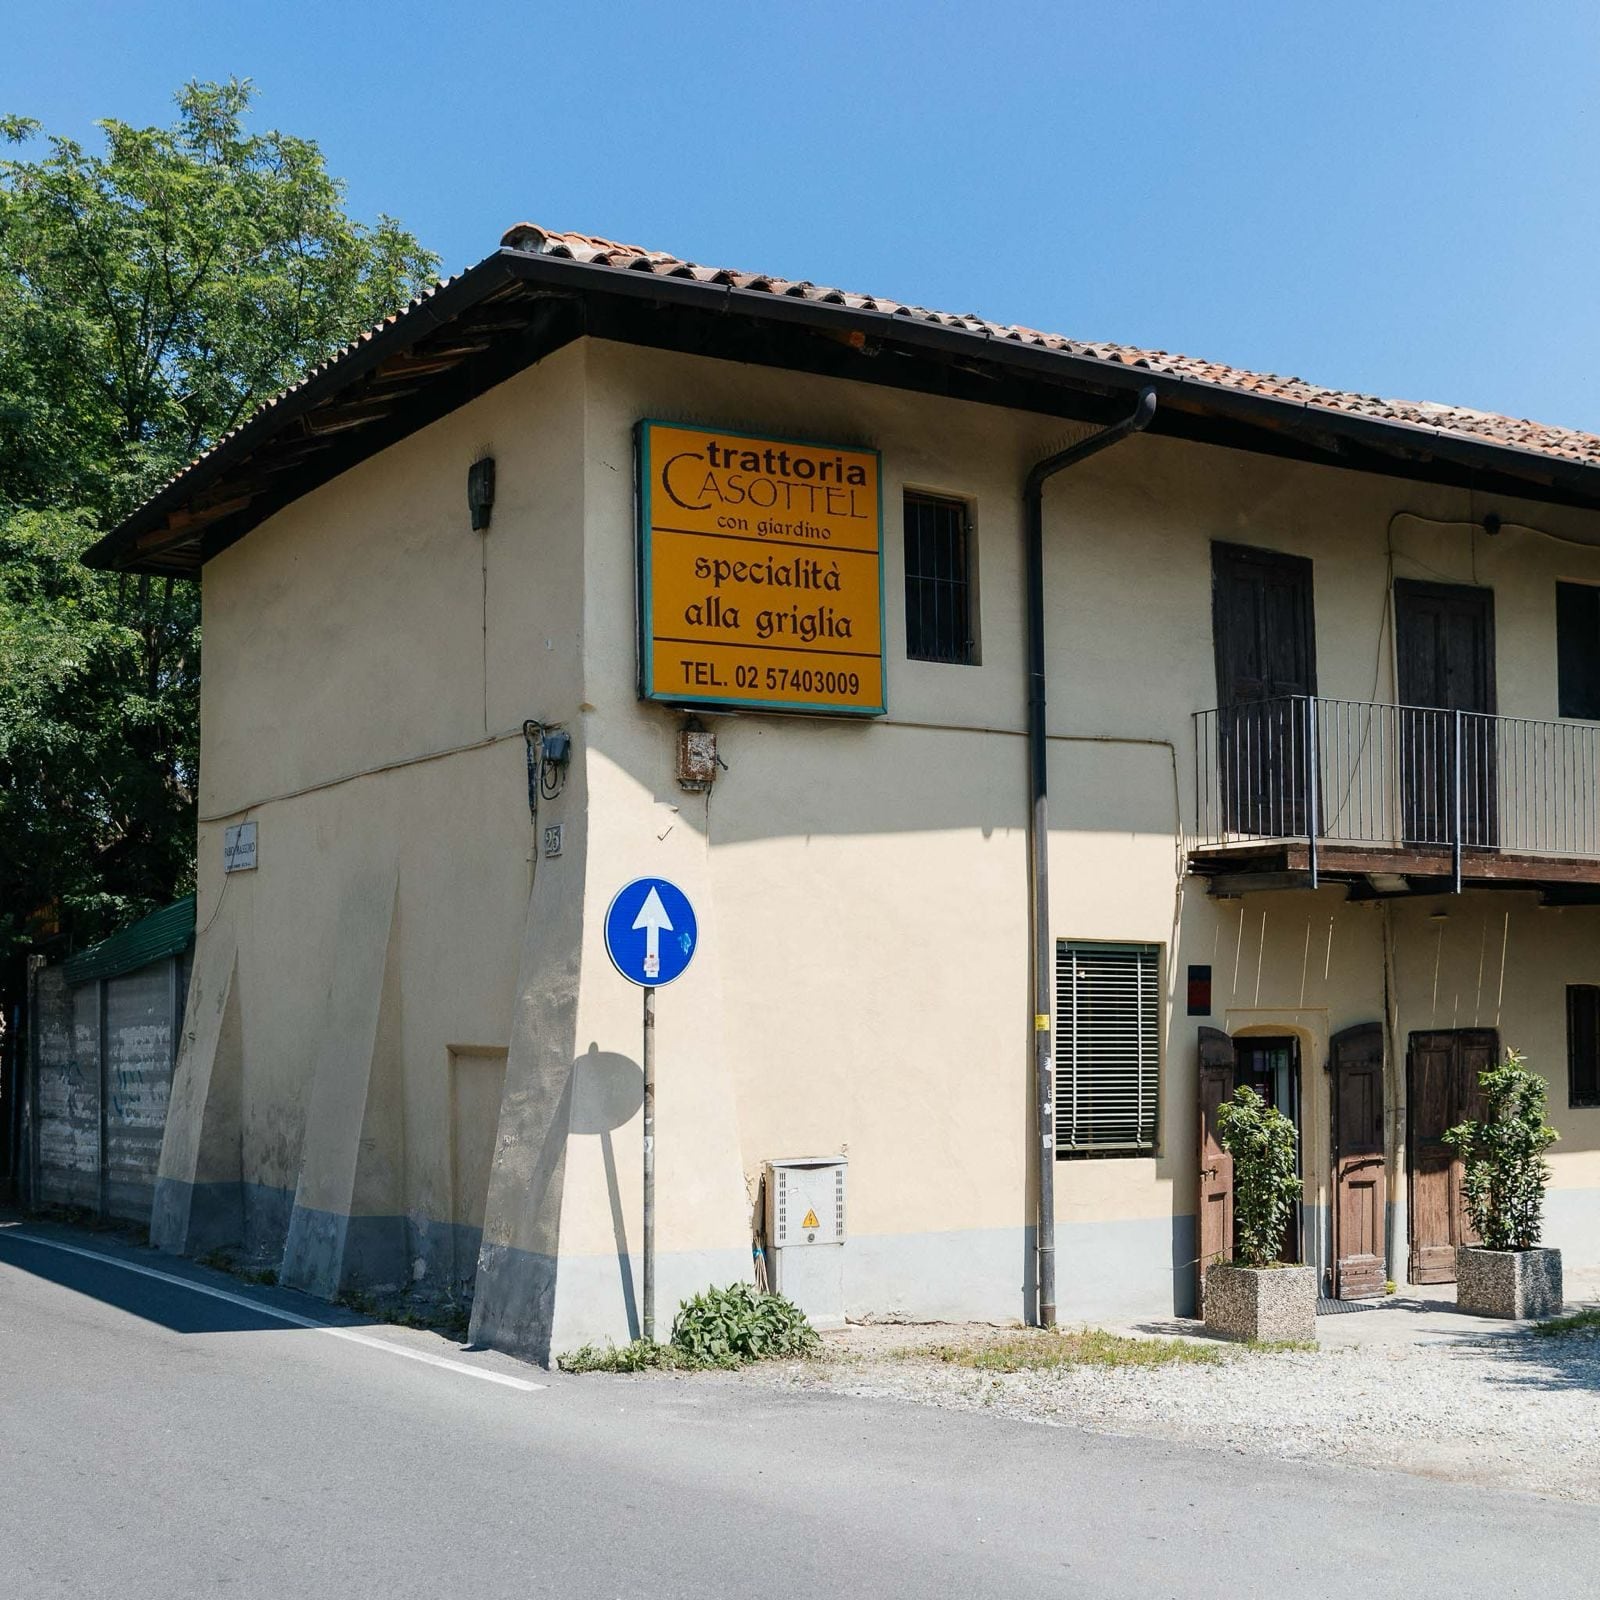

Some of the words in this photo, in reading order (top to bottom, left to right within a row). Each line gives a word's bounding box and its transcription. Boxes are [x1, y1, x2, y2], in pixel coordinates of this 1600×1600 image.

[707, 441, 866, 486] trattoria
[662, 453, 868, 519] CASOTTEL
[718, 516, 748, 530] con
[757, 518, 832, 539] giardino
[695, 556, 842, 592] specialità
[685, 596, 741, 629] alla
[756, 605, 853, 643] griglia
[680, 660, 728, 687] TEL.
[736, 665, 759, 689] 02
[766, 667, 860, 696] 57403009
[545, 830, 559, 850] 25
